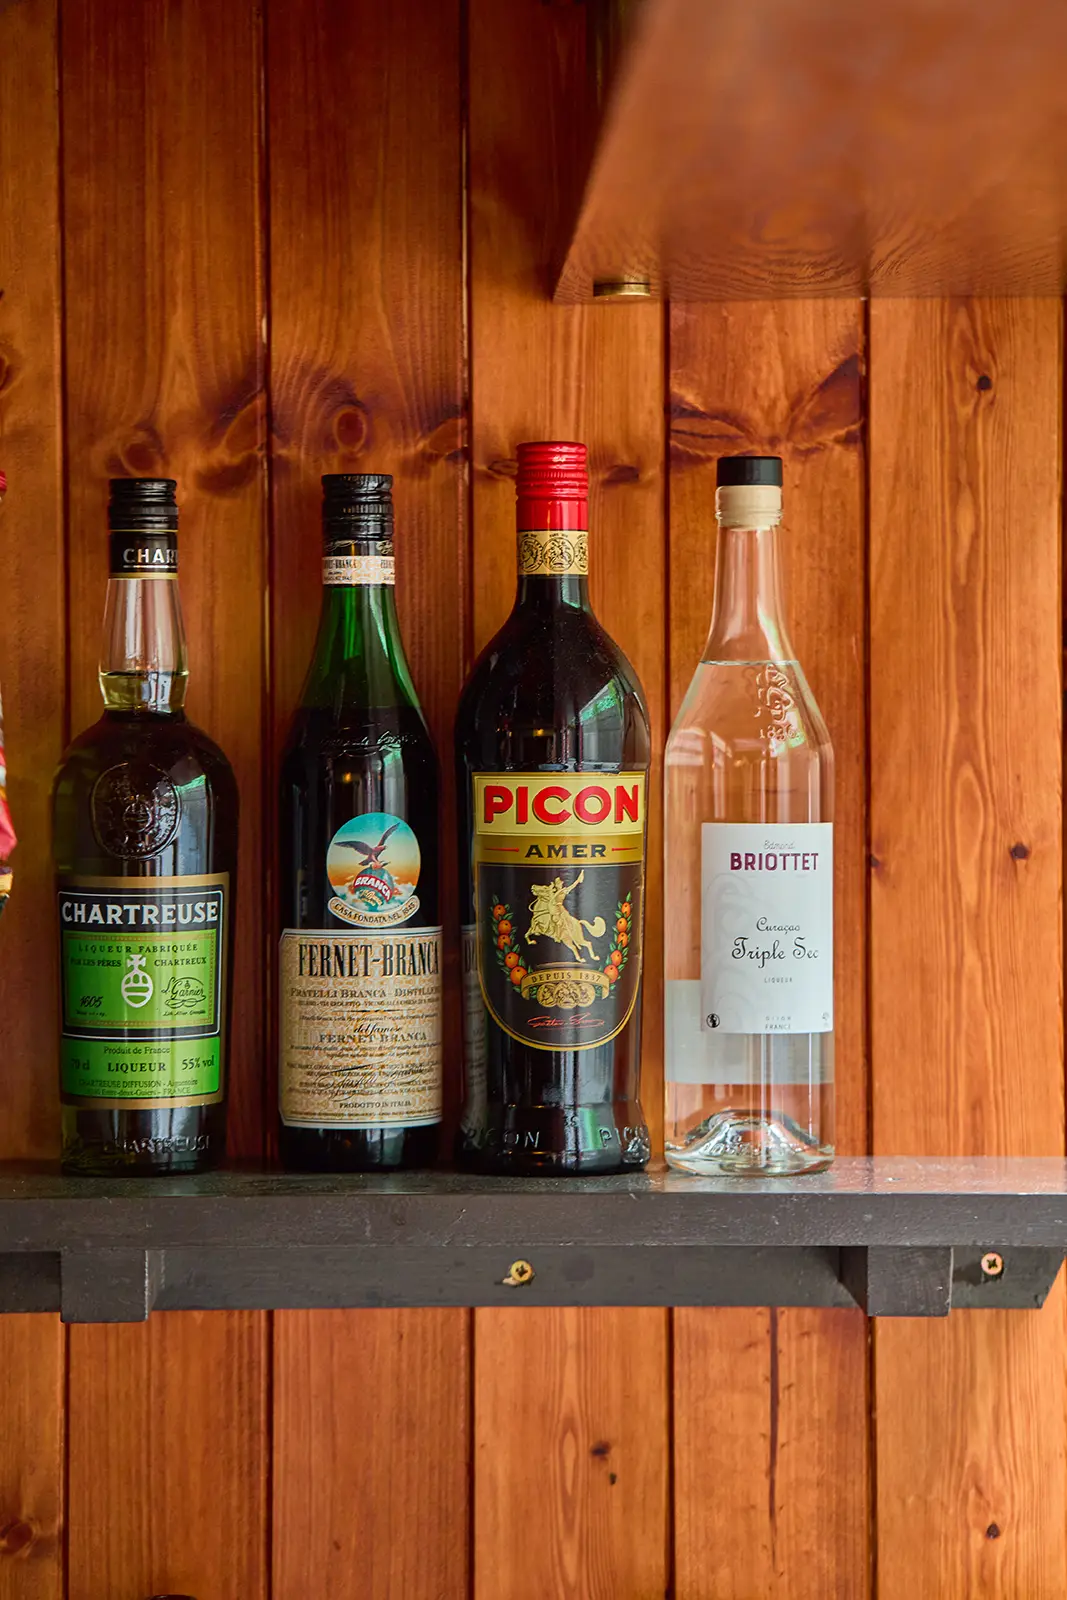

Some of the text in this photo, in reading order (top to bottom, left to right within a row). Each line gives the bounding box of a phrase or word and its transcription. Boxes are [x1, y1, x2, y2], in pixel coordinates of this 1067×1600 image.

[484, 784, 639, 825] PICON
[525, 844, 607, 858] AMER
[730, 852, 819, 871] BRIOTTET
[355, 876, 391, 900] BRANCA
[61, 901, 219, 925] CHARTREUSE
[334, 903, 352, 918] CASA
[353, 913, 387, 923] FONDATA
[756, 916, 800, 935] Curaçao
[78, 942, 198, 954] LIQUEUR FABRIQUÉE
[731, 936, 819, 968] Triple Sec
[154, 957, 207, 967] CHARTREUX
[298, 940, 439, 977] FERNET-BRANCA
[531, 971, 602, 983] DEPUIS 1837
[763, 976, 793, 984] LIQUEUR
[80, 995, 103, 1008] 1605
[341, 988, 386, 999] BRANCA
[103, 1045, 170, 1055] Produit de France
[107, 1062, 167, 1074] LIQUEUR
[182, 1056, 201, 1071] 55%
[202, 1054, 215, 1068] vol
[339, 1101, 381, 1109] PRODOTTO
